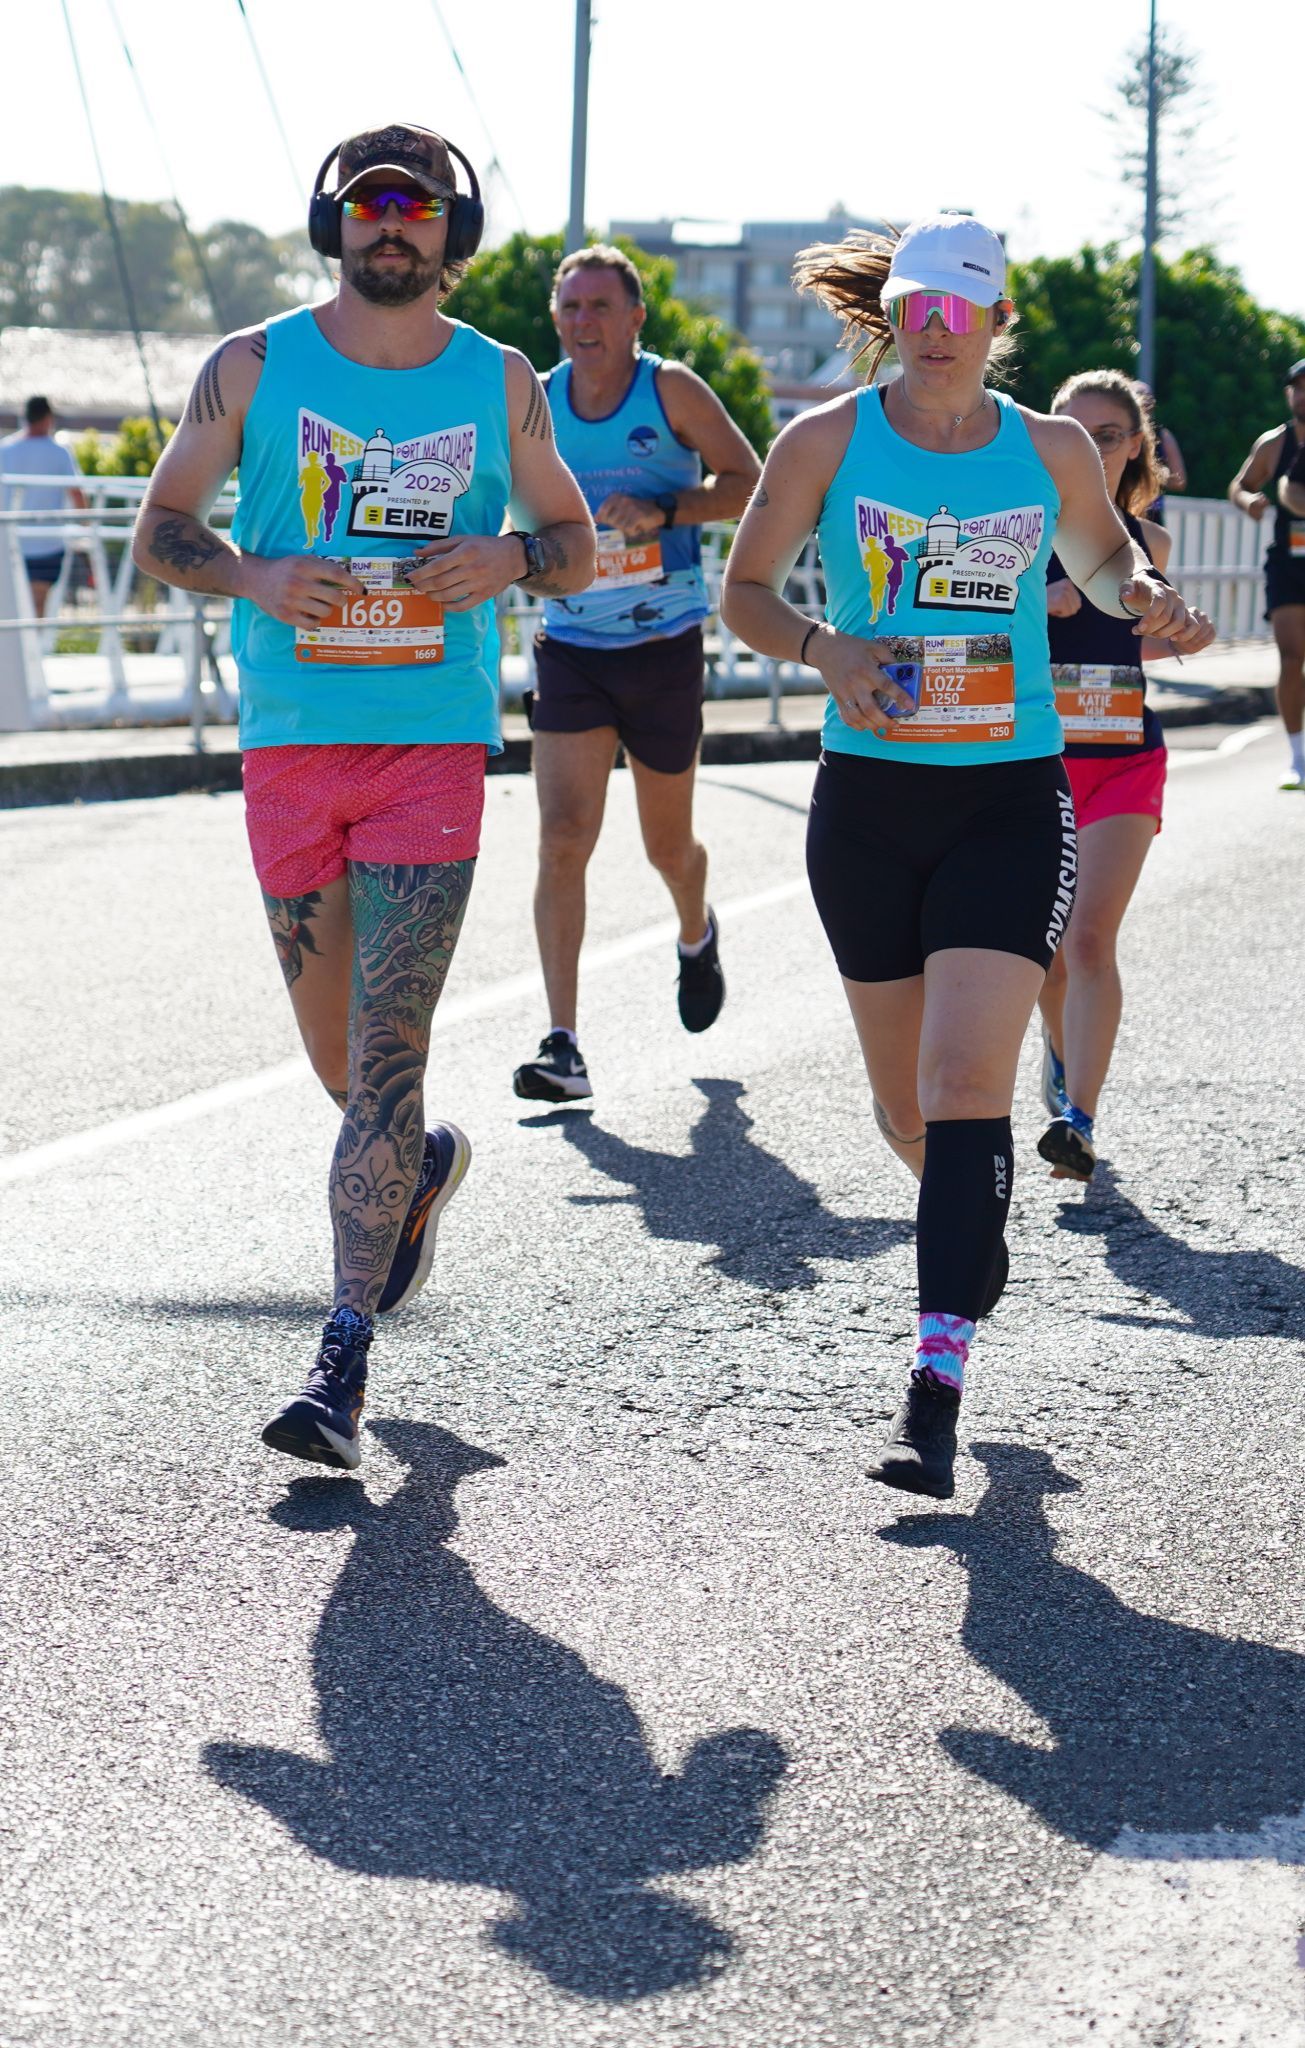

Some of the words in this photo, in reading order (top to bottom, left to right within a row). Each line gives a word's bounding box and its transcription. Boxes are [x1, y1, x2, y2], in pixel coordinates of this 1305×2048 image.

[302, 416, 365, 457] RUNFEST
[396, 442, 420, 459] PORT
[404, 473, 451, 492] 2025
[387, 496, 421, 505] PRESENTED
[384, 507, 448, 530] EIRE
[858, 504, 924, 543] RUNFEST
[963, 518, 990, 536] PORT
[969, 548, 1017, 570] 2025
[952, 569, 986, 578] PRESENTED
[950, 580, 1013, 602] EIRE
[341, 599, 404, 627] 1669
[925, 638, 966, 648] RUNFEST
[414, 648, 437, 660] 1669
[955, 666, 985, 675] Macquarie
[925, 675, 966, 692] LOZZ
[930, 692, 960, 705] 1250
[1078, 693, 1112, 708] KATIE
[988, 726, 1010, 738] 1250
[1045, 789, 1079, 953] GYMSHARK
[993, 1154, 1007, 1199] 2XU
